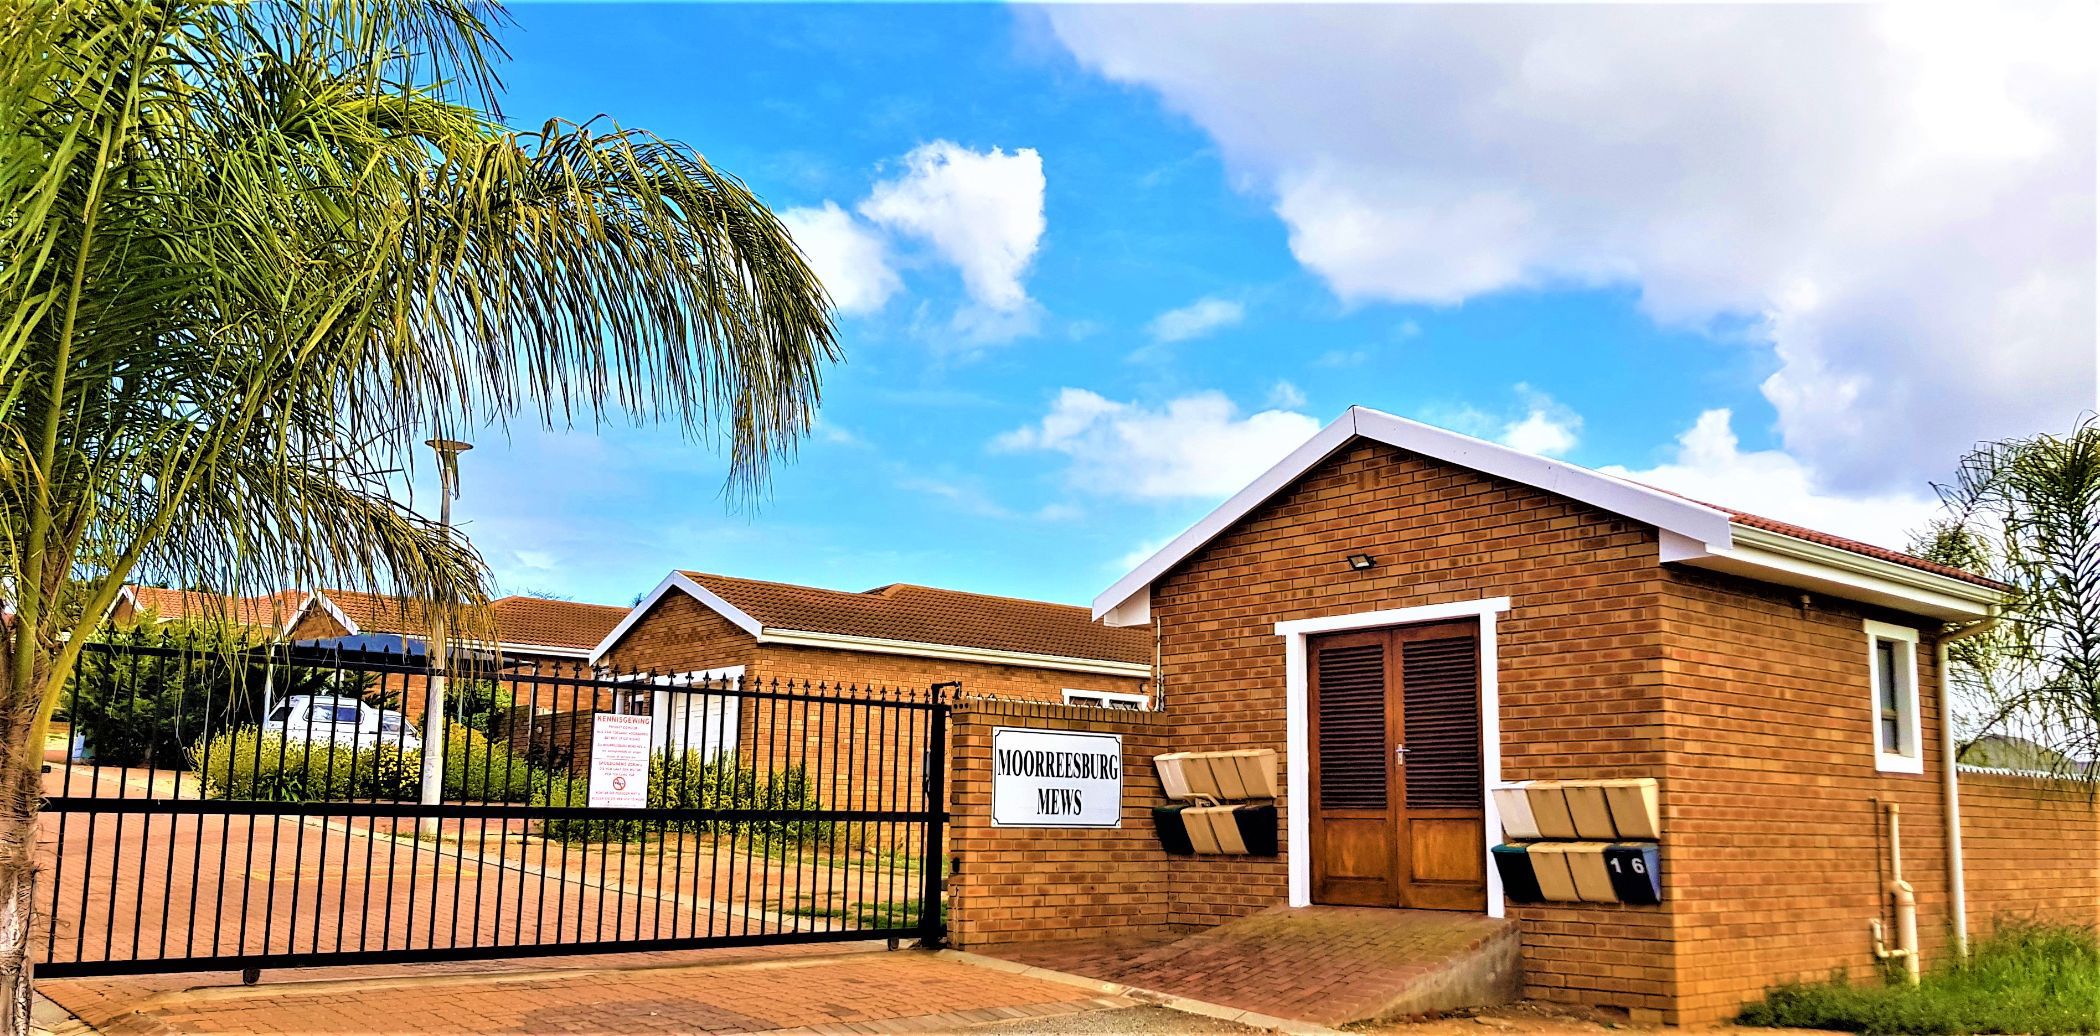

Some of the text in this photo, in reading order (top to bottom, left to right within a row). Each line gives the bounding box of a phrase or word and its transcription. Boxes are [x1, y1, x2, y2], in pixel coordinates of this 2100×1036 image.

[597, 715, 650, 725] KENNISGEWING
[997, 749, 1119, 780] MOORREESBURG
[1037, 788, 1082, 816] MEWS
